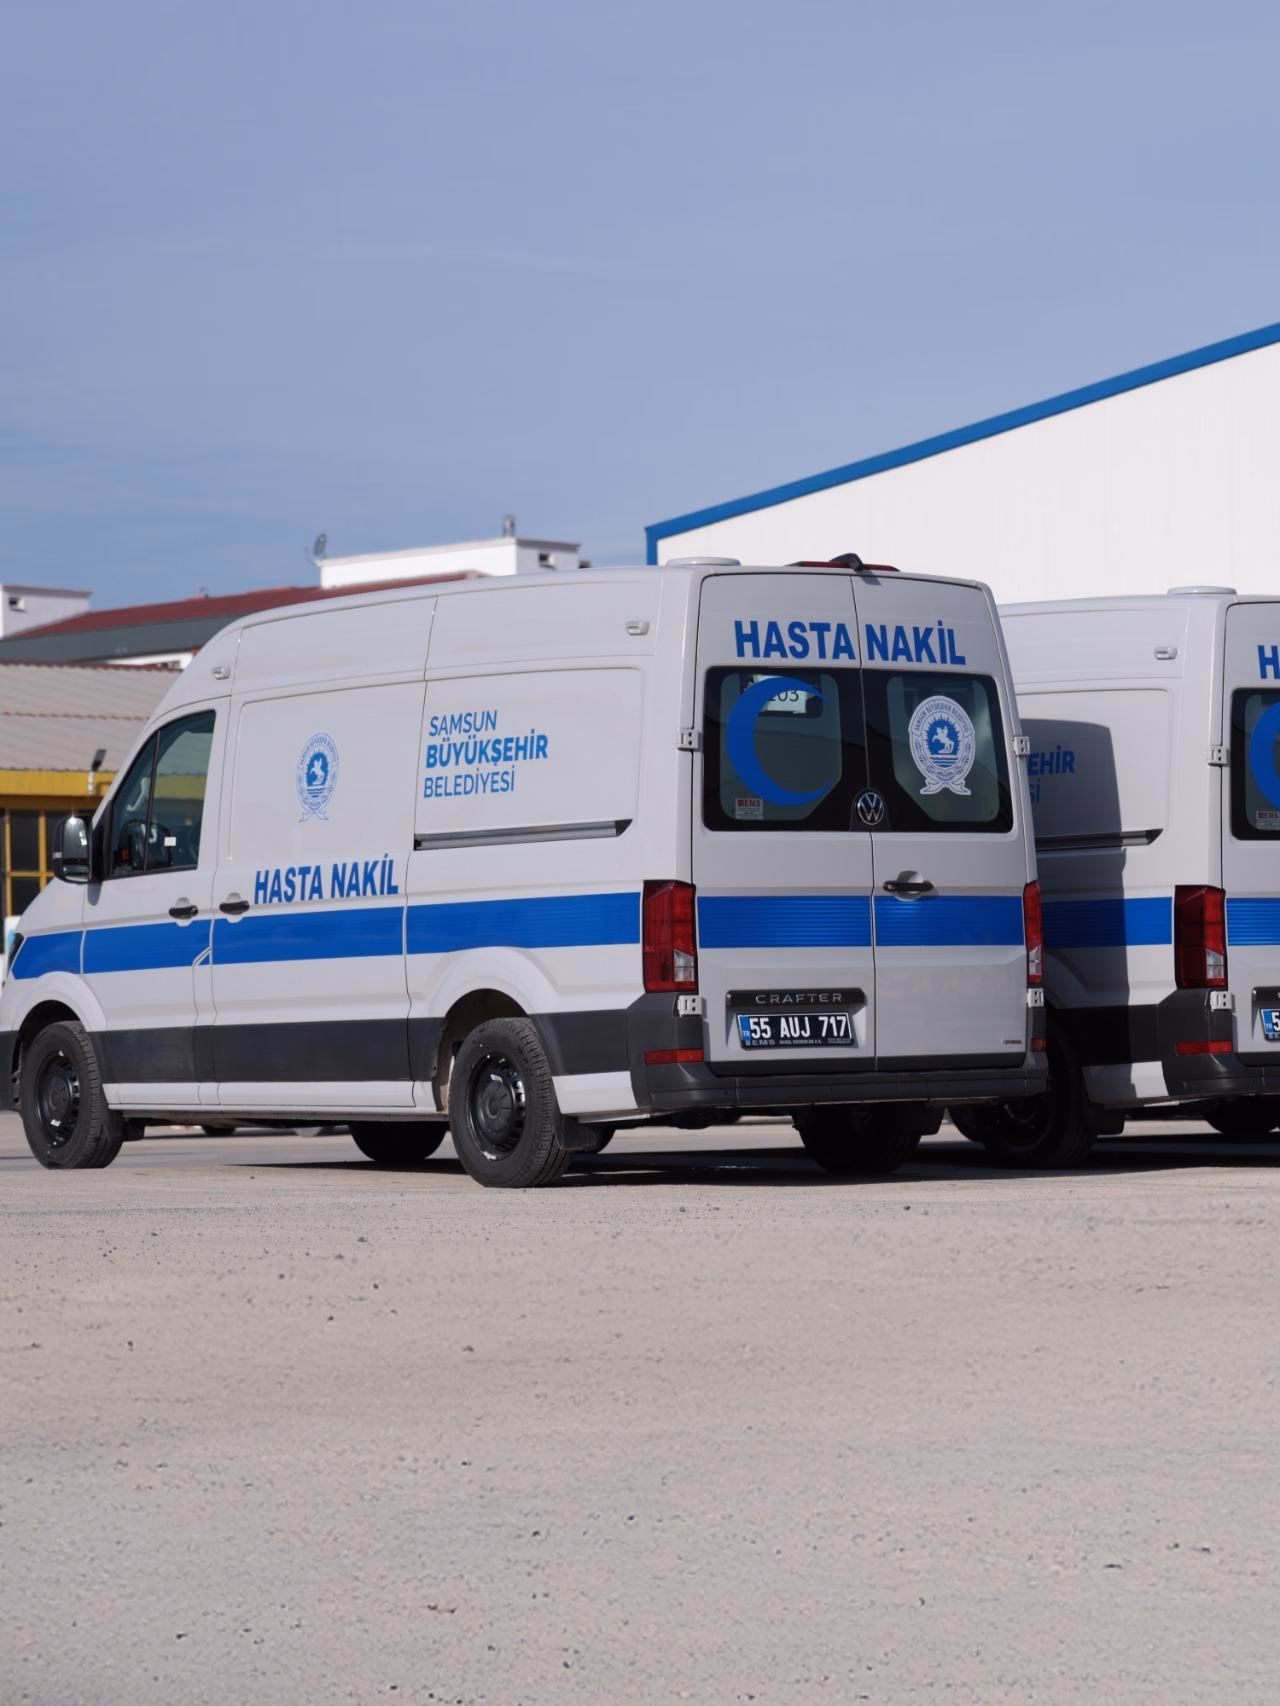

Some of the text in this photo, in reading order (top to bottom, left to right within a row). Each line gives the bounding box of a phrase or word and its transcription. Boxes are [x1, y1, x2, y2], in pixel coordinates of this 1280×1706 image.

[734, 619, 966, 665] HASTA NAKİL
[429, 710, 497, 736] SAMSUN
[426, 729, 549, 768] BÜYÜKŞEHİR
[424, 765, 515, 798] BELEDİYESİ
[254, 853, 399, 904] HASTA NAKİL
[755, 993, 842, 1004] CRAFTER
[749, 1015, 847, 1039] 55 AUJ 717
